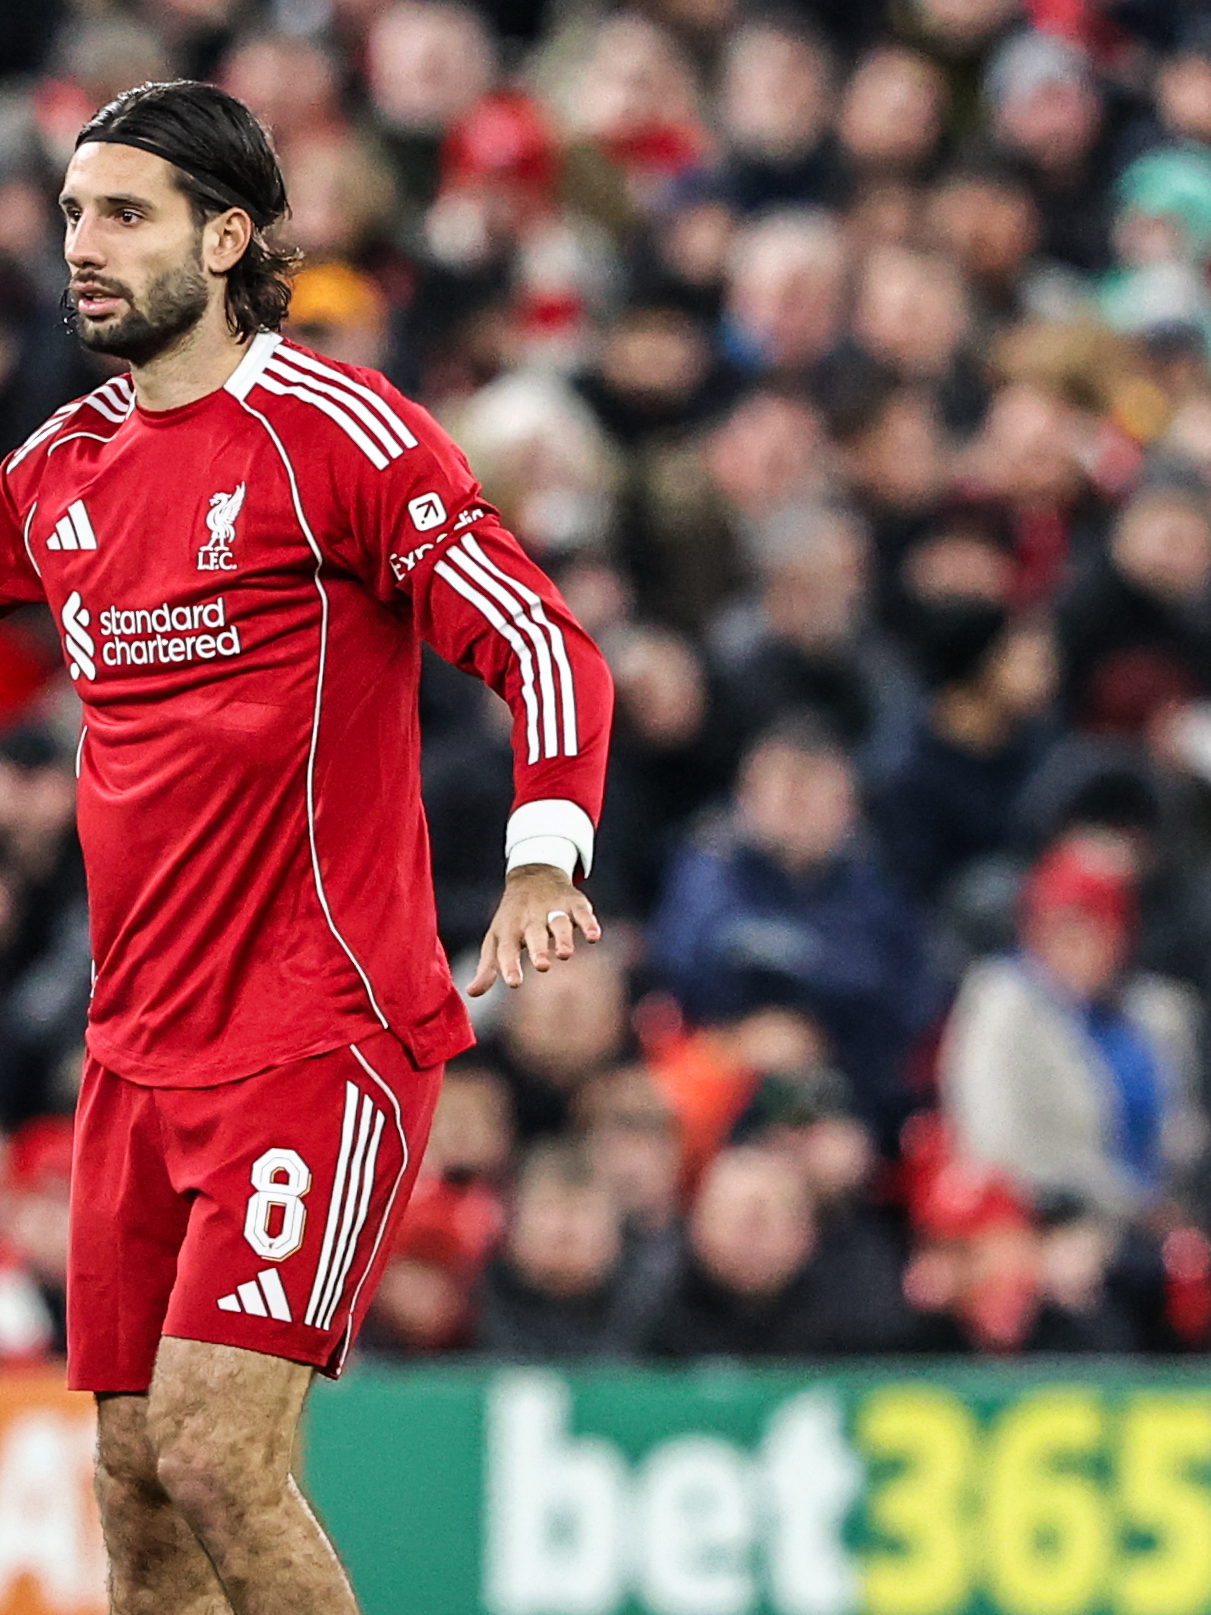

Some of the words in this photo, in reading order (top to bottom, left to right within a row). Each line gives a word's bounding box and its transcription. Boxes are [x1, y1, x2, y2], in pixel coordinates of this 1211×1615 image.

[99, 596, 227, 636] standard
[102, 625, 242, 666] chartered
[244, 1147, 313, 1262] 8
[484, 1368, 1211, 1615] bet365
